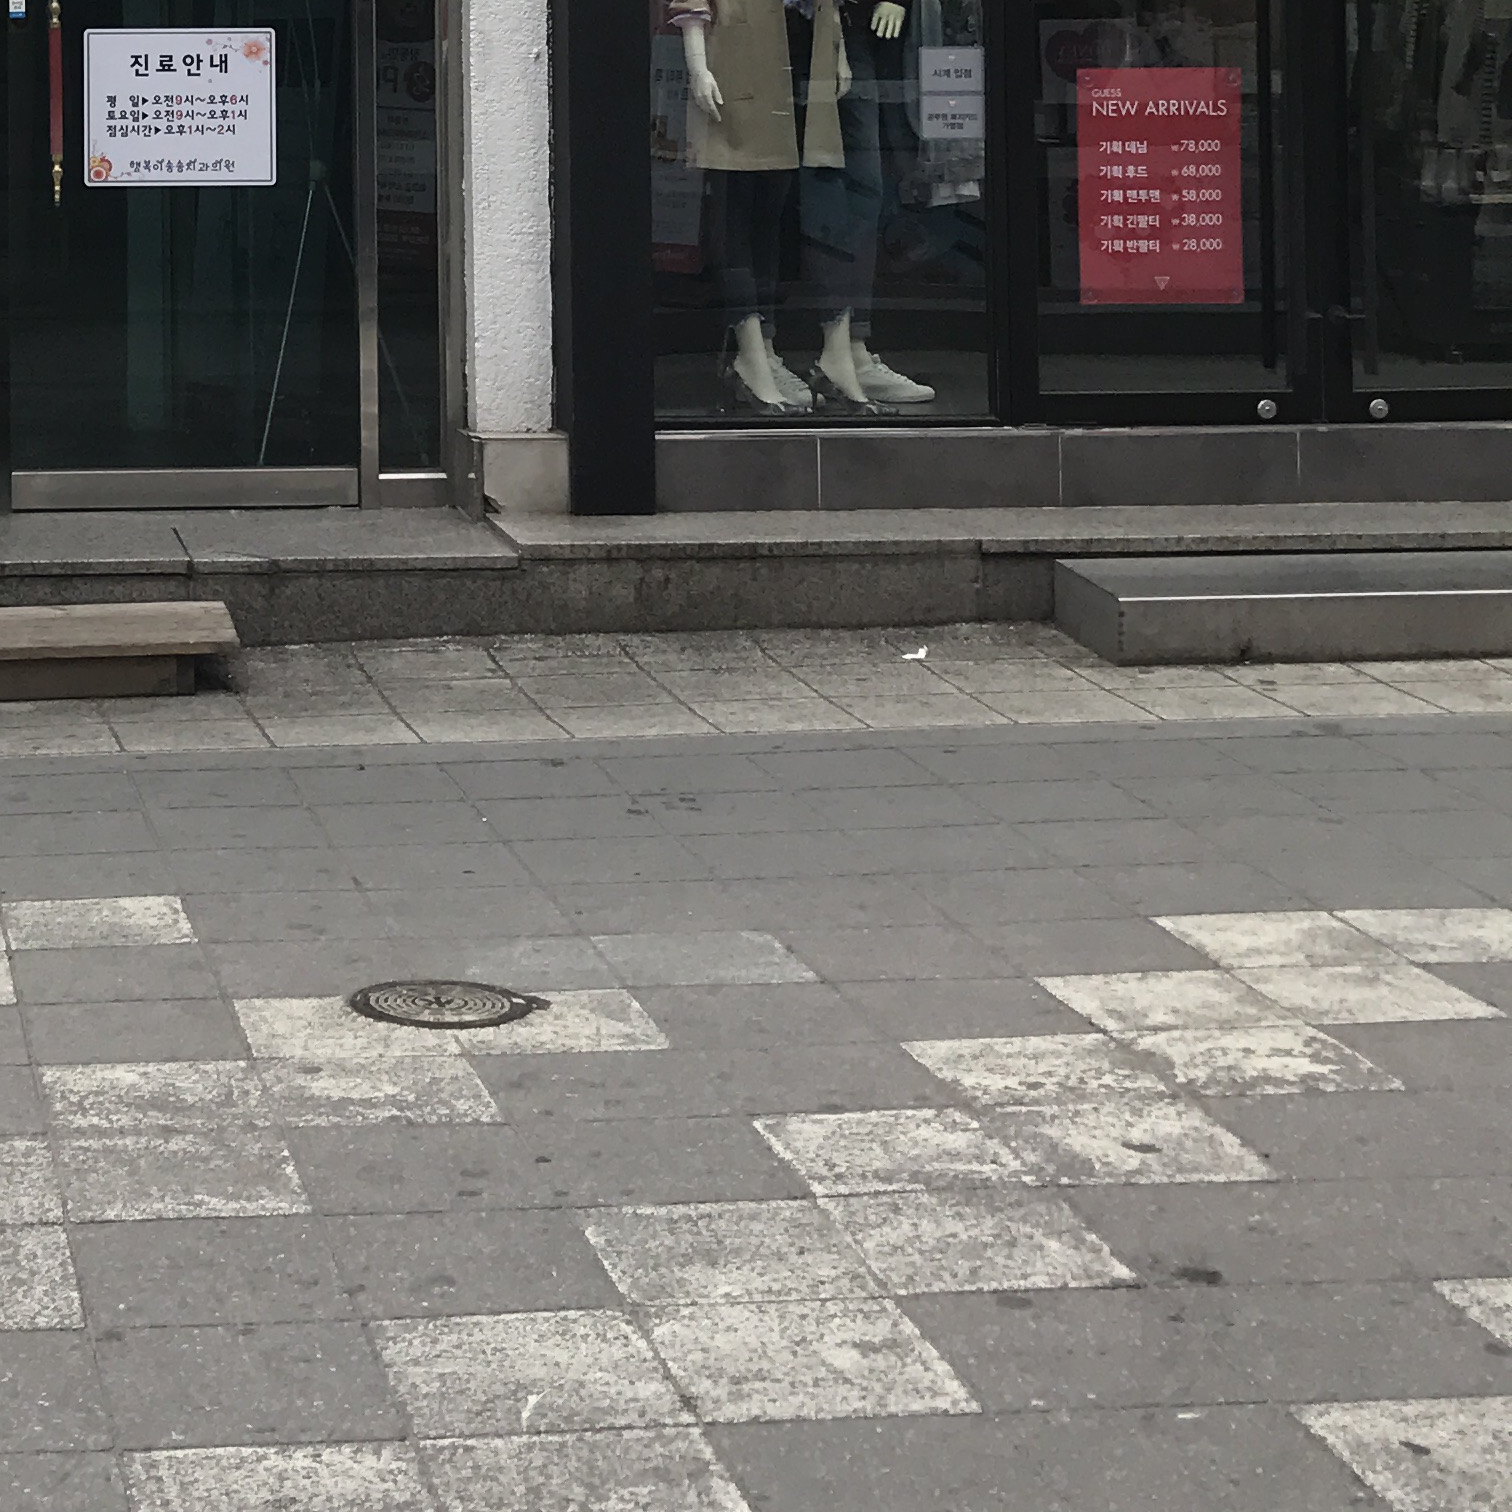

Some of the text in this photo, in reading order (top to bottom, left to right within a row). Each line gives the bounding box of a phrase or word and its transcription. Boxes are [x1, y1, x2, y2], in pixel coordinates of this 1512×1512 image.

[129, 53, 229, 77] 진료안내
[1092, 89, 1121, 97] GUESS
[1092, 99, 1228, 116] NEW ARRIVALS
[1125, 141, 1148, 153] 데님
[1125, 166, 1148, 178] 후드
